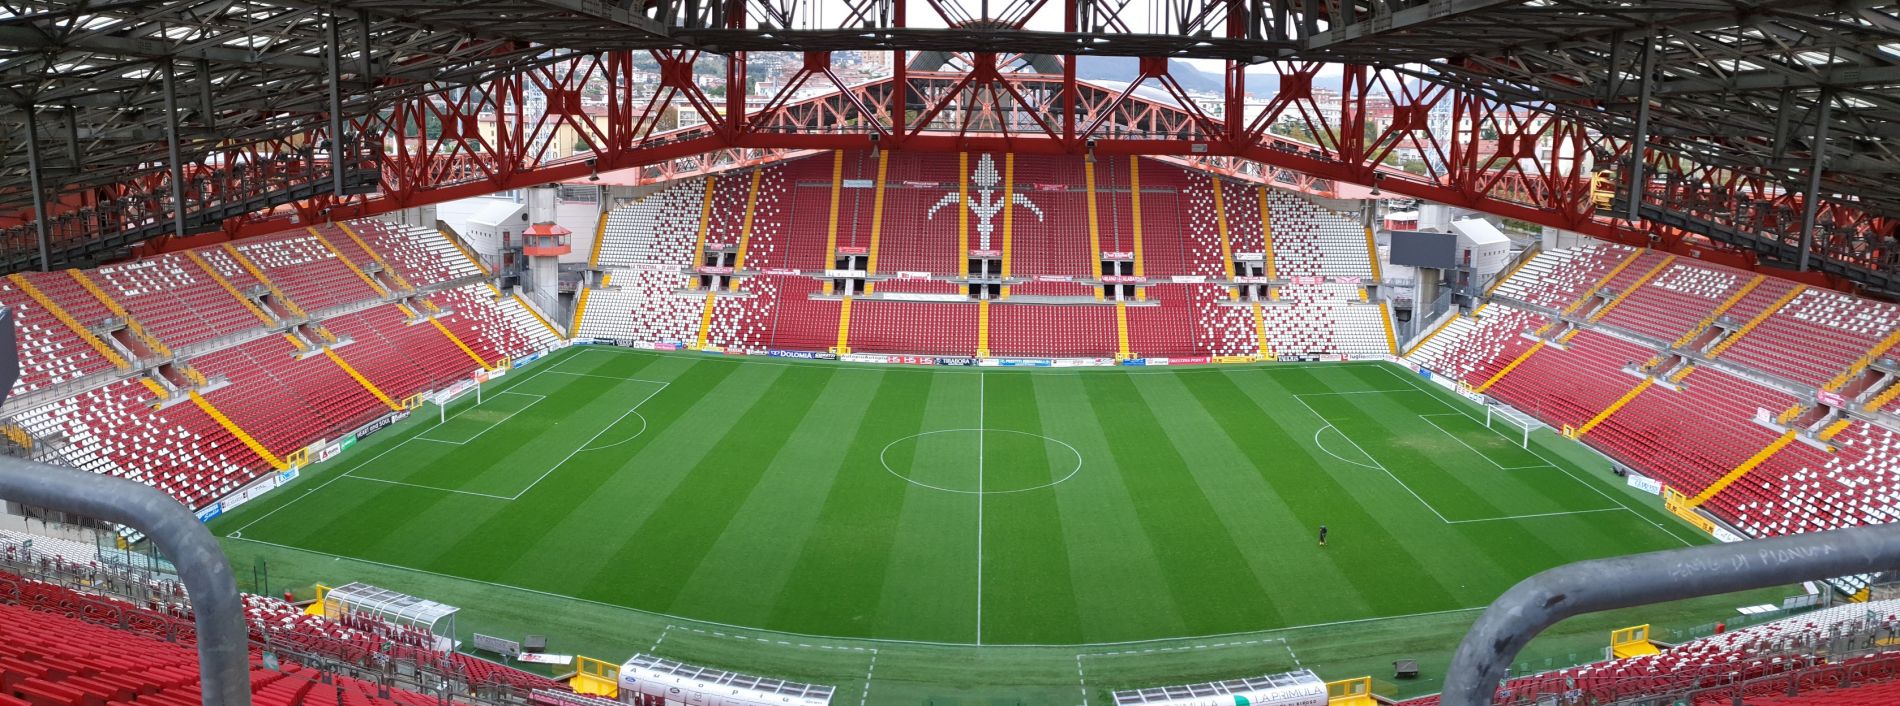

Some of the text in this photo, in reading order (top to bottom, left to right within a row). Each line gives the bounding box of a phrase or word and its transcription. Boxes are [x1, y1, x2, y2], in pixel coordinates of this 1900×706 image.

[237, 235, 337, 270] TRIESTE
[1653, 264, 1737, 299] CURVA
[1776, 288, 1900, 336] FURLAN
[1271, 686, 1323, 700] PRIMULA
